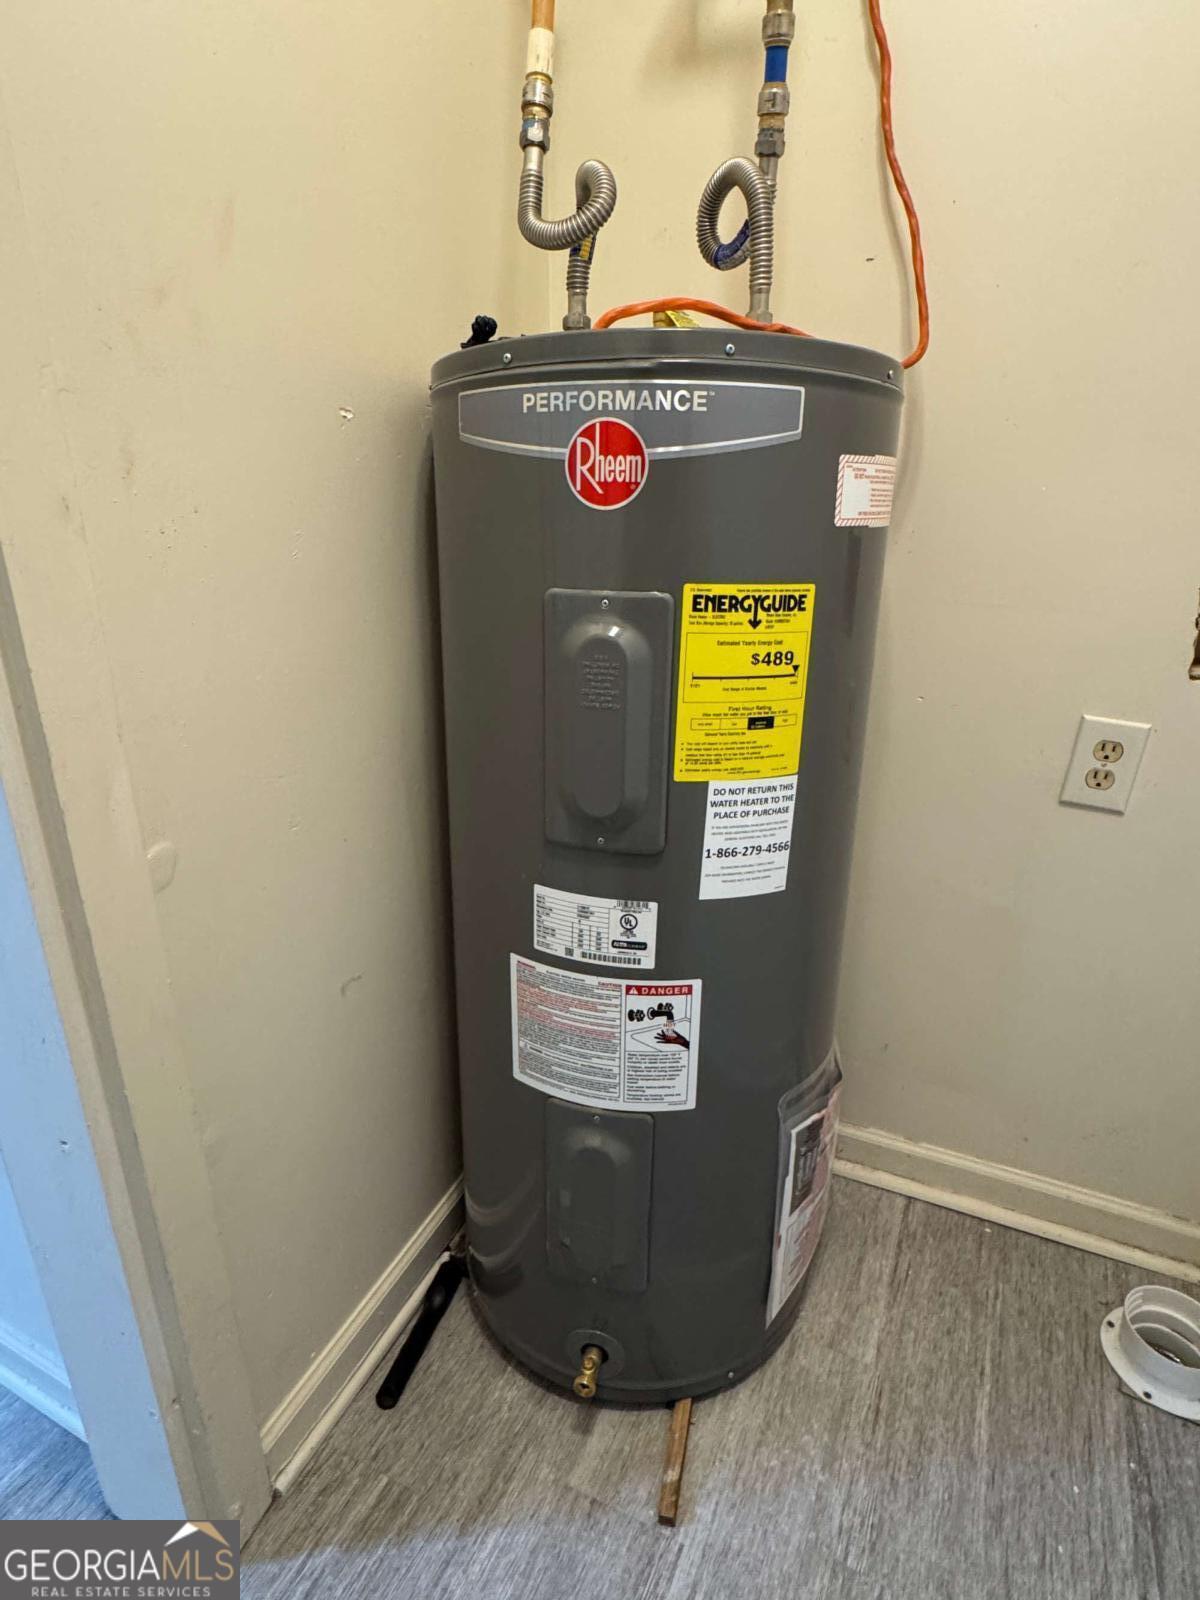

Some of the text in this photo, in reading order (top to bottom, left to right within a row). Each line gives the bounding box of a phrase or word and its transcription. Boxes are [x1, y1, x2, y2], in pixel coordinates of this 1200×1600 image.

[522, 390, 708, 413] PERFORMANCE
[575, 422, 642, 494] Rheem
[692, 594, 807, 615] ENERGYGUIDE
[751, 651, 794, 666] $489
[713, 783, 794, 796] DO NOT RETURN THIS
[710, 794, 794, 808] WATER HEATER TO THE
[713, 806, 790, 820] PLACE OF PURCHASE
[705, 841, 790, 858] 1-866-279-4566
[624, 916, 633, 927] UL
[641, 986, 689, 995] DANGER
